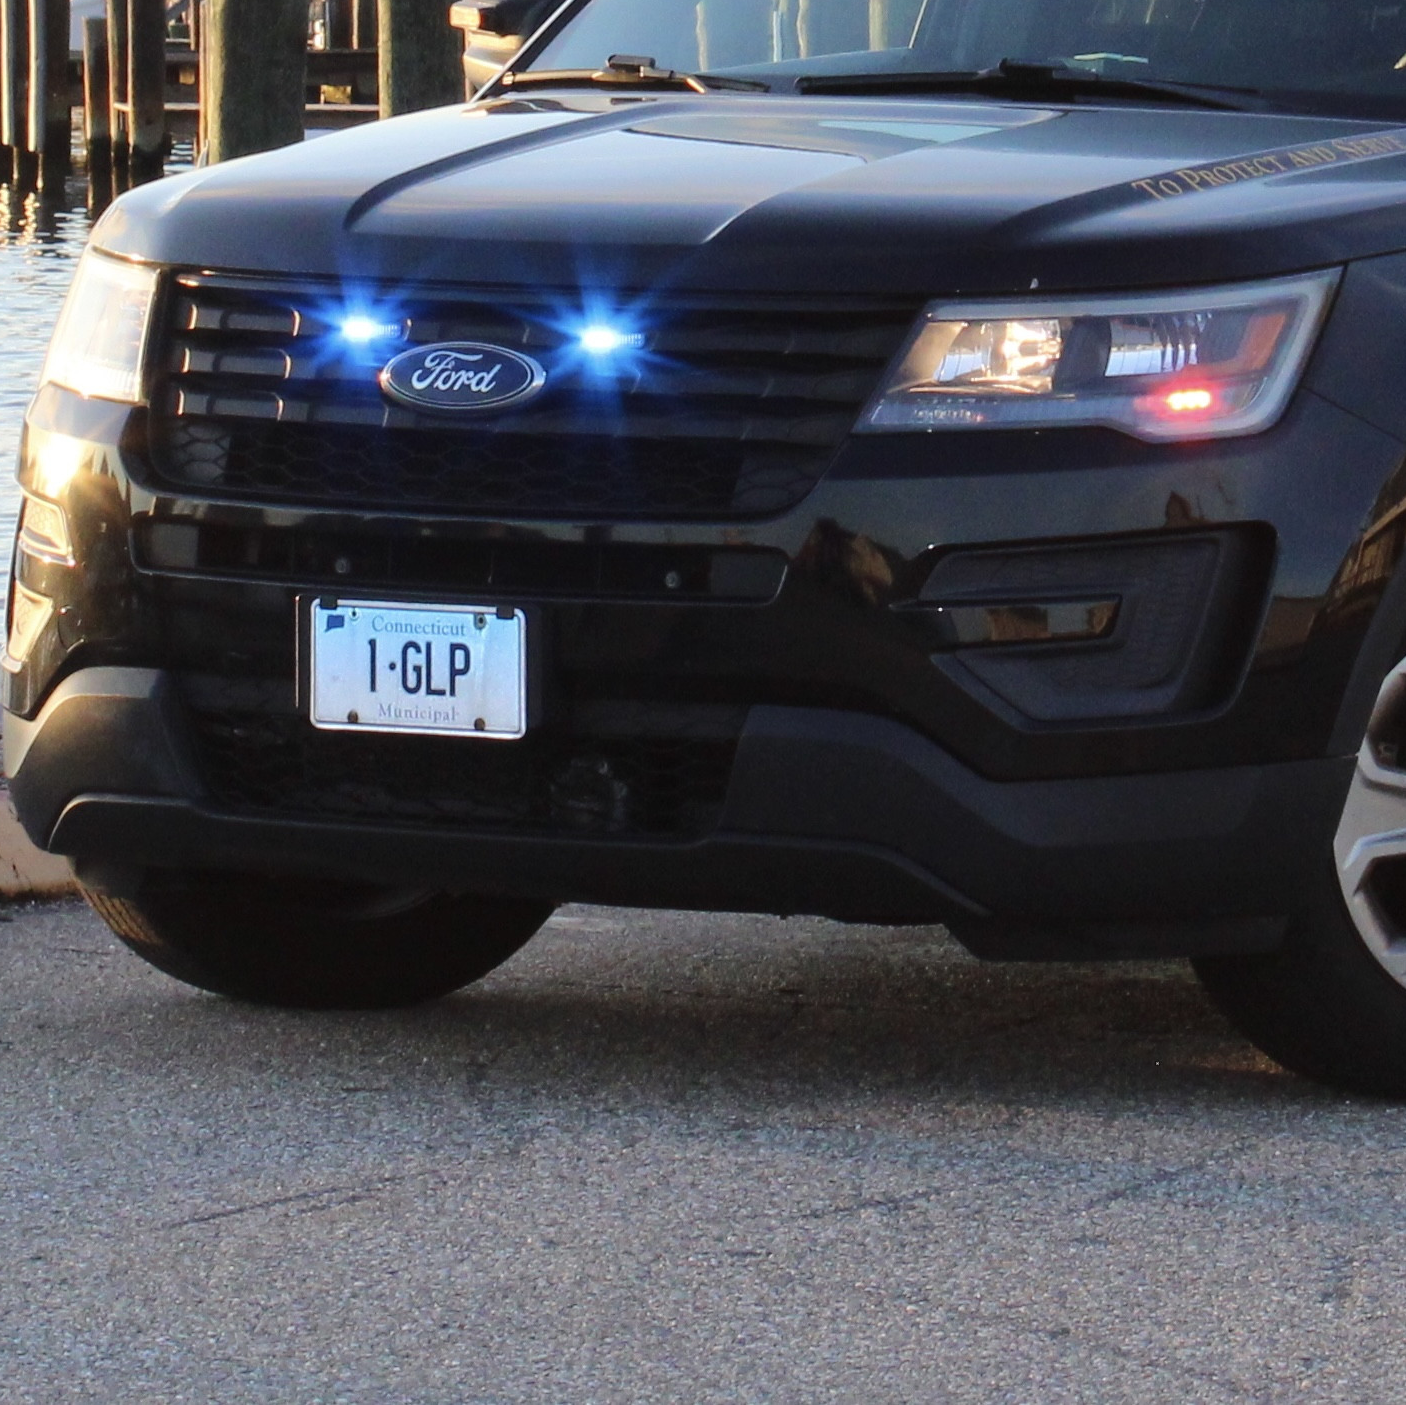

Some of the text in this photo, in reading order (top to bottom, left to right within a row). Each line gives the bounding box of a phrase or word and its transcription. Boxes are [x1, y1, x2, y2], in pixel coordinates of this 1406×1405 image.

[1131, 178, 1184, 202] TO
[1175, 154, 1288, 192] PROTECT
[1287, 145, 1338, 168] AND
[411, 350, 502, 393] Ford
[371, 615, 467, 636] Connecticut
[378, 703, 458, 723] Municipal
